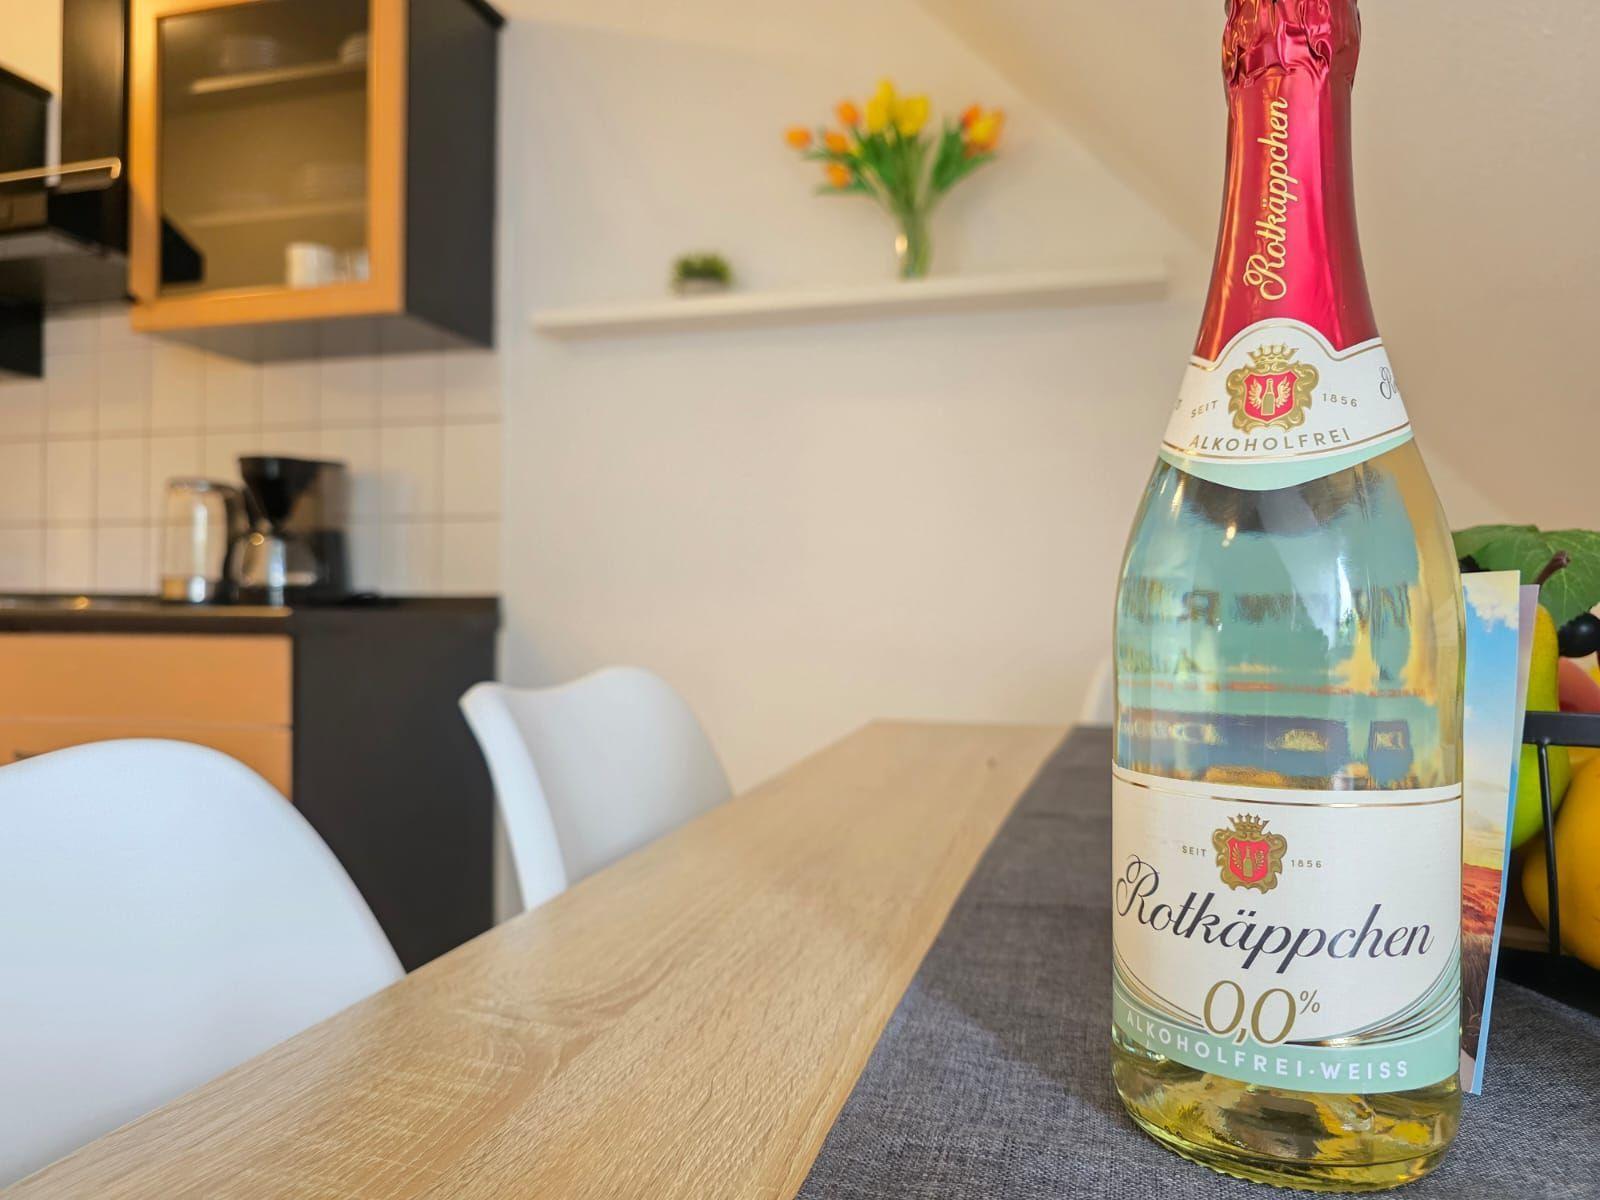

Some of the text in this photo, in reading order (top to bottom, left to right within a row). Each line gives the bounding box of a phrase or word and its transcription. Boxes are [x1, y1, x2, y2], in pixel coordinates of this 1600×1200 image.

[1243, 97, 1298, 300] Rotkäppchen
[1191, 400, 1218, 418] SEIT
[1322, 393, 1358, 408] 1856
[1188, 428, 1350, 451] ALKOHOLFREI
[1182, 845, 1322, 869] SEIT 1856
[1116, 854, 1435, 974] Rotkäppchen
